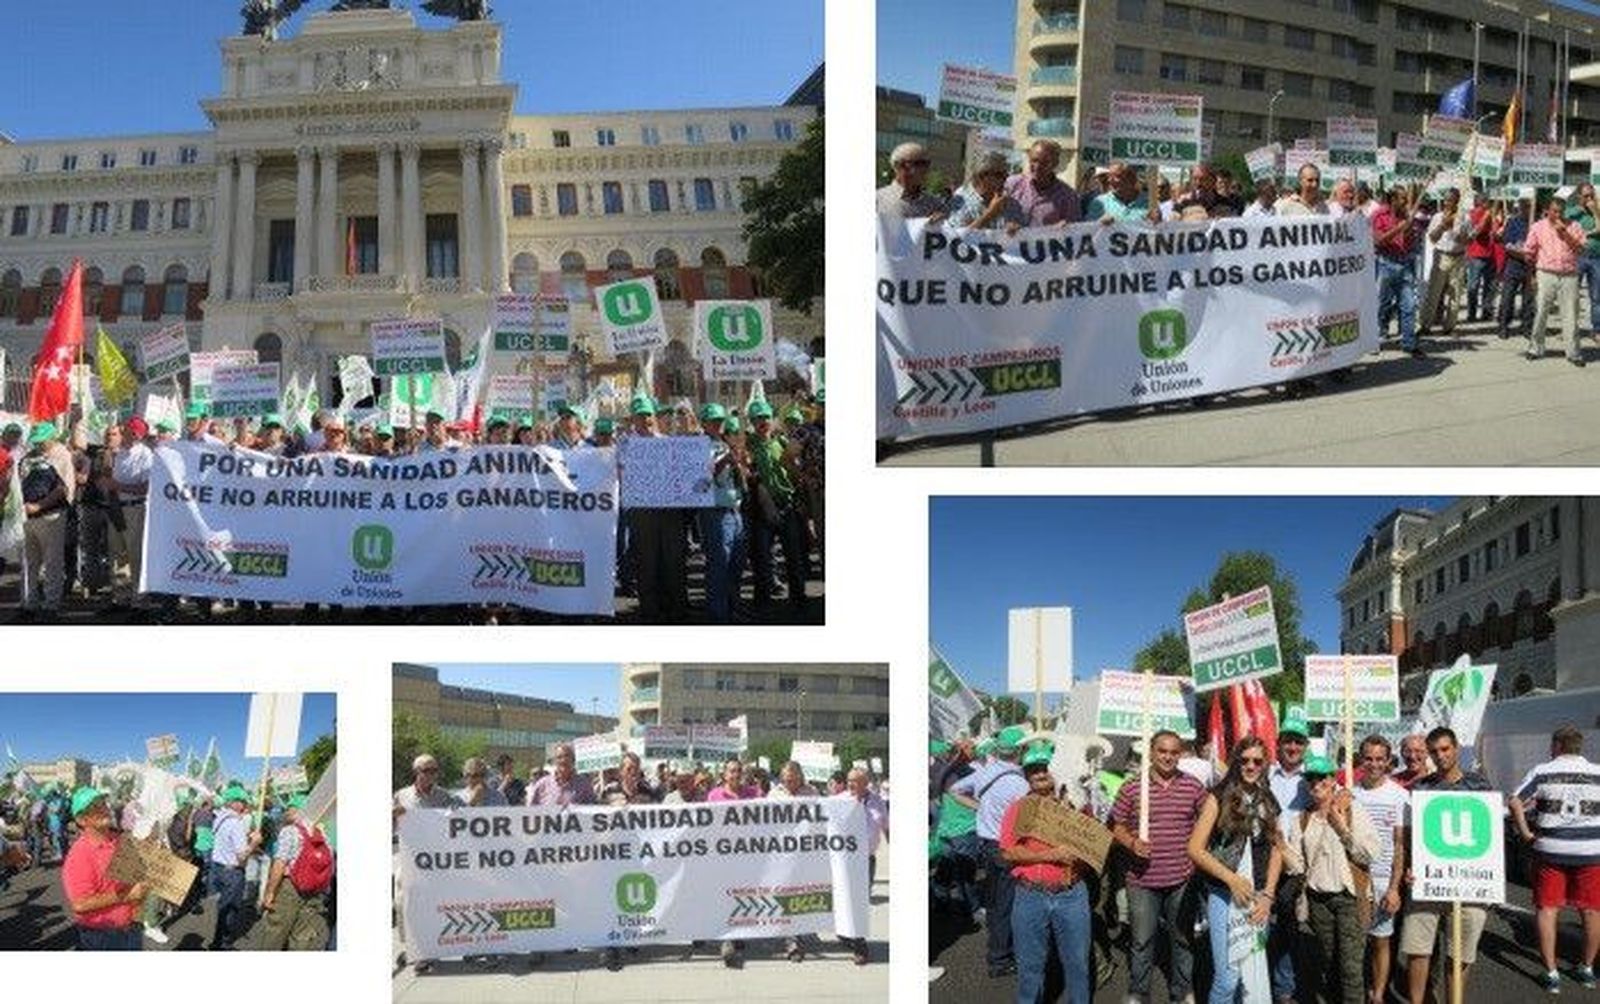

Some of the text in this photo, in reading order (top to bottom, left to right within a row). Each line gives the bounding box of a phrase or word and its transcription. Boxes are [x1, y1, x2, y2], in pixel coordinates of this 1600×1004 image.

[951, 105, 996, 122] UCCL
[1127, 141, 1181, 158] UCCL
[923, 222, 1355, 265] POR UNA SANIDAD ANIMAL
[877, 279, 947, 305] QUE
[960, 282, 1011, 305] NO
[1022, 272, 1157, 304] ARRUINE
[1167, 271, 1185, 290] A
[1195, 266, 1243, 287] LOS
[950, 355, 967, 367] DE
[971, 346, 1063, 366] CAMPESINOS
[992, 364, 1053, 391] UCCL
[1150, 377, 1203, 393] Uniones
[893, 404, 947, 420] Castilla
[951, 406, 958, 419] y
[200, 453, 254, 475] POR
[266, 457, 324, 478] UNA
[334, 457, 457, 480] SANIDAD
[163, 483, 614, 511] QUE NO ARRUINE A LOS GANADEROS
[238, 555, 283, 575] UCCL
[536, 562, 579, 585] UCCL
[1208, 652, 1264, 680] UCCL
[449, 804, 829, 838] POR UNA SANIDAD ANIMAL
[415, 834, 858, 870] QUE NO ARRUINE A LOS GANADEROS
[1425, 864, 1443, 879] La
[790, 895, 827, 912] UCCL
[507, 911, 550, 927] UCCL
